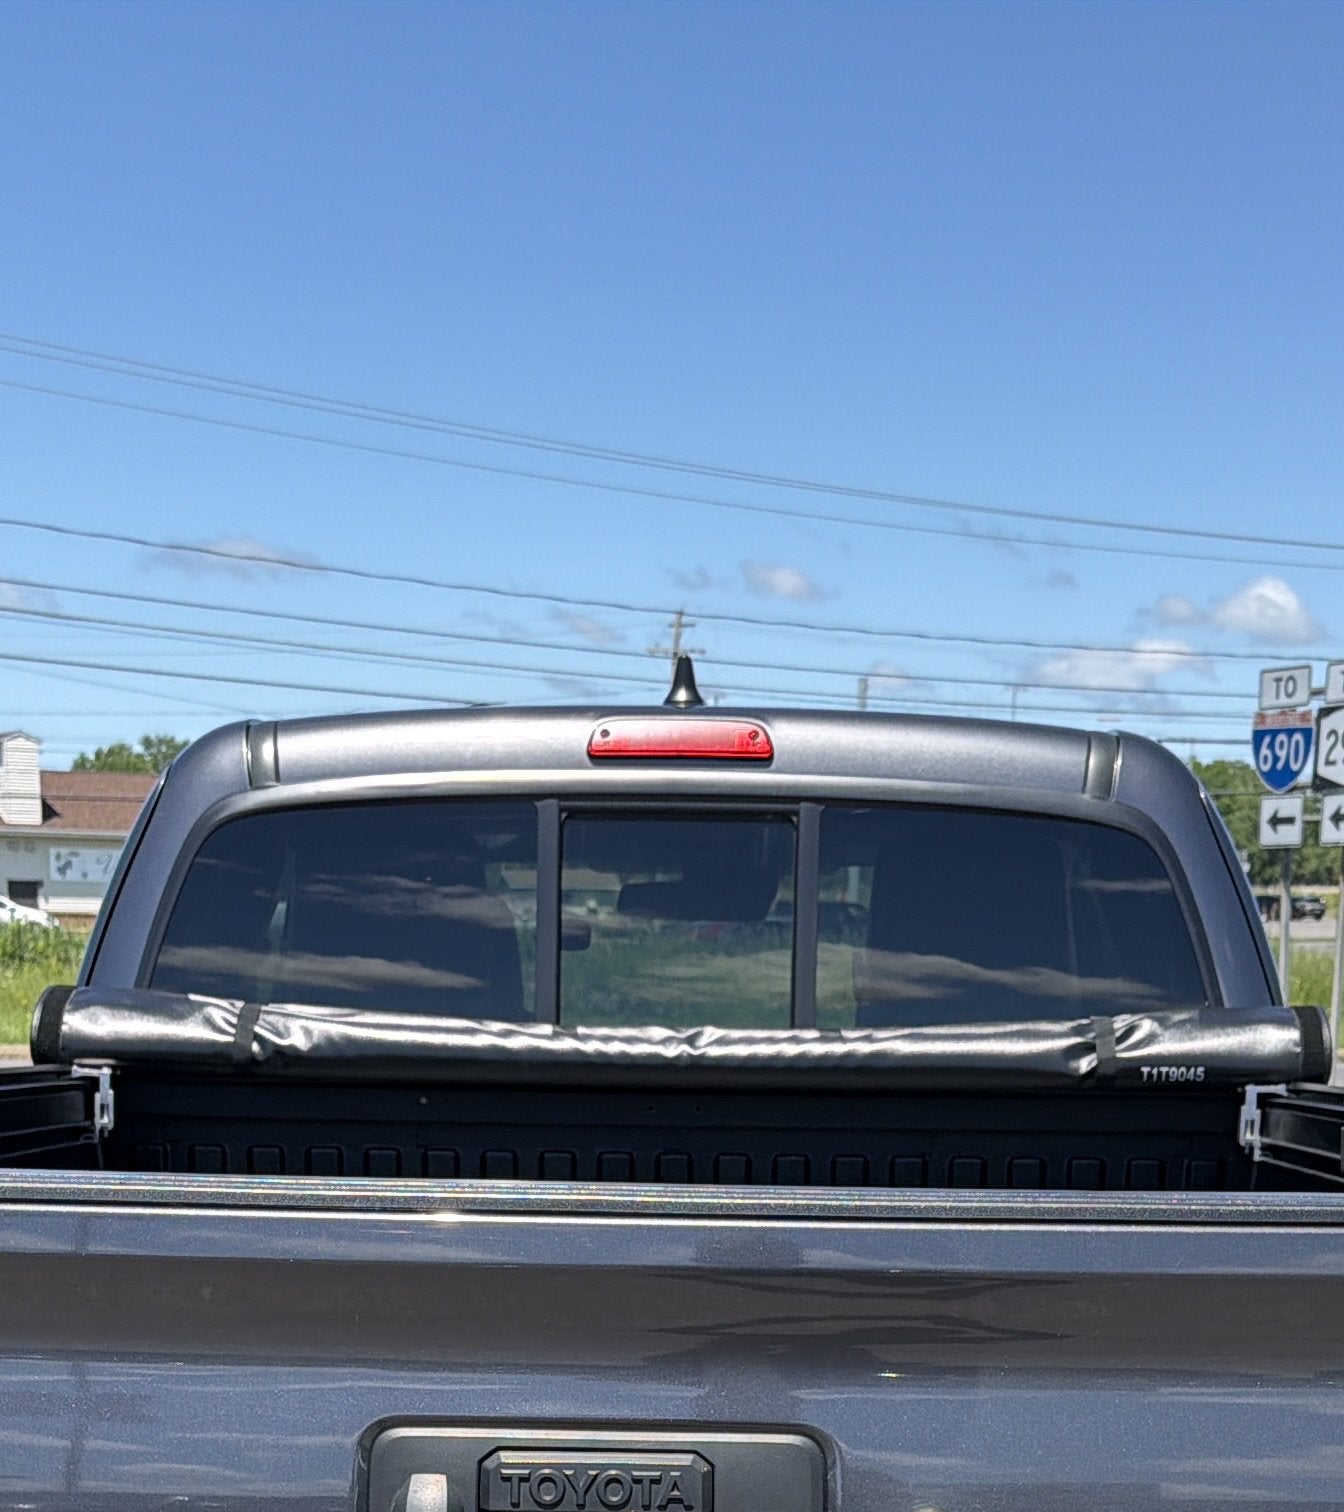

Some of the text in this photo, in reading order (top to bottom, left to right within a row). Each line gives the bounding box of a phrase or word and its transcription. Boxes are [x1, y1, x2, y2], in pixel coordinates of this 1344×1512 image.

[1273, 675, 1297, 700] TO
[1258, 732, 1305, 773] 690
[1141, 1066, 1205, 1082] T1T9045
[500, 1468, 695, 1511] TOYOTA
